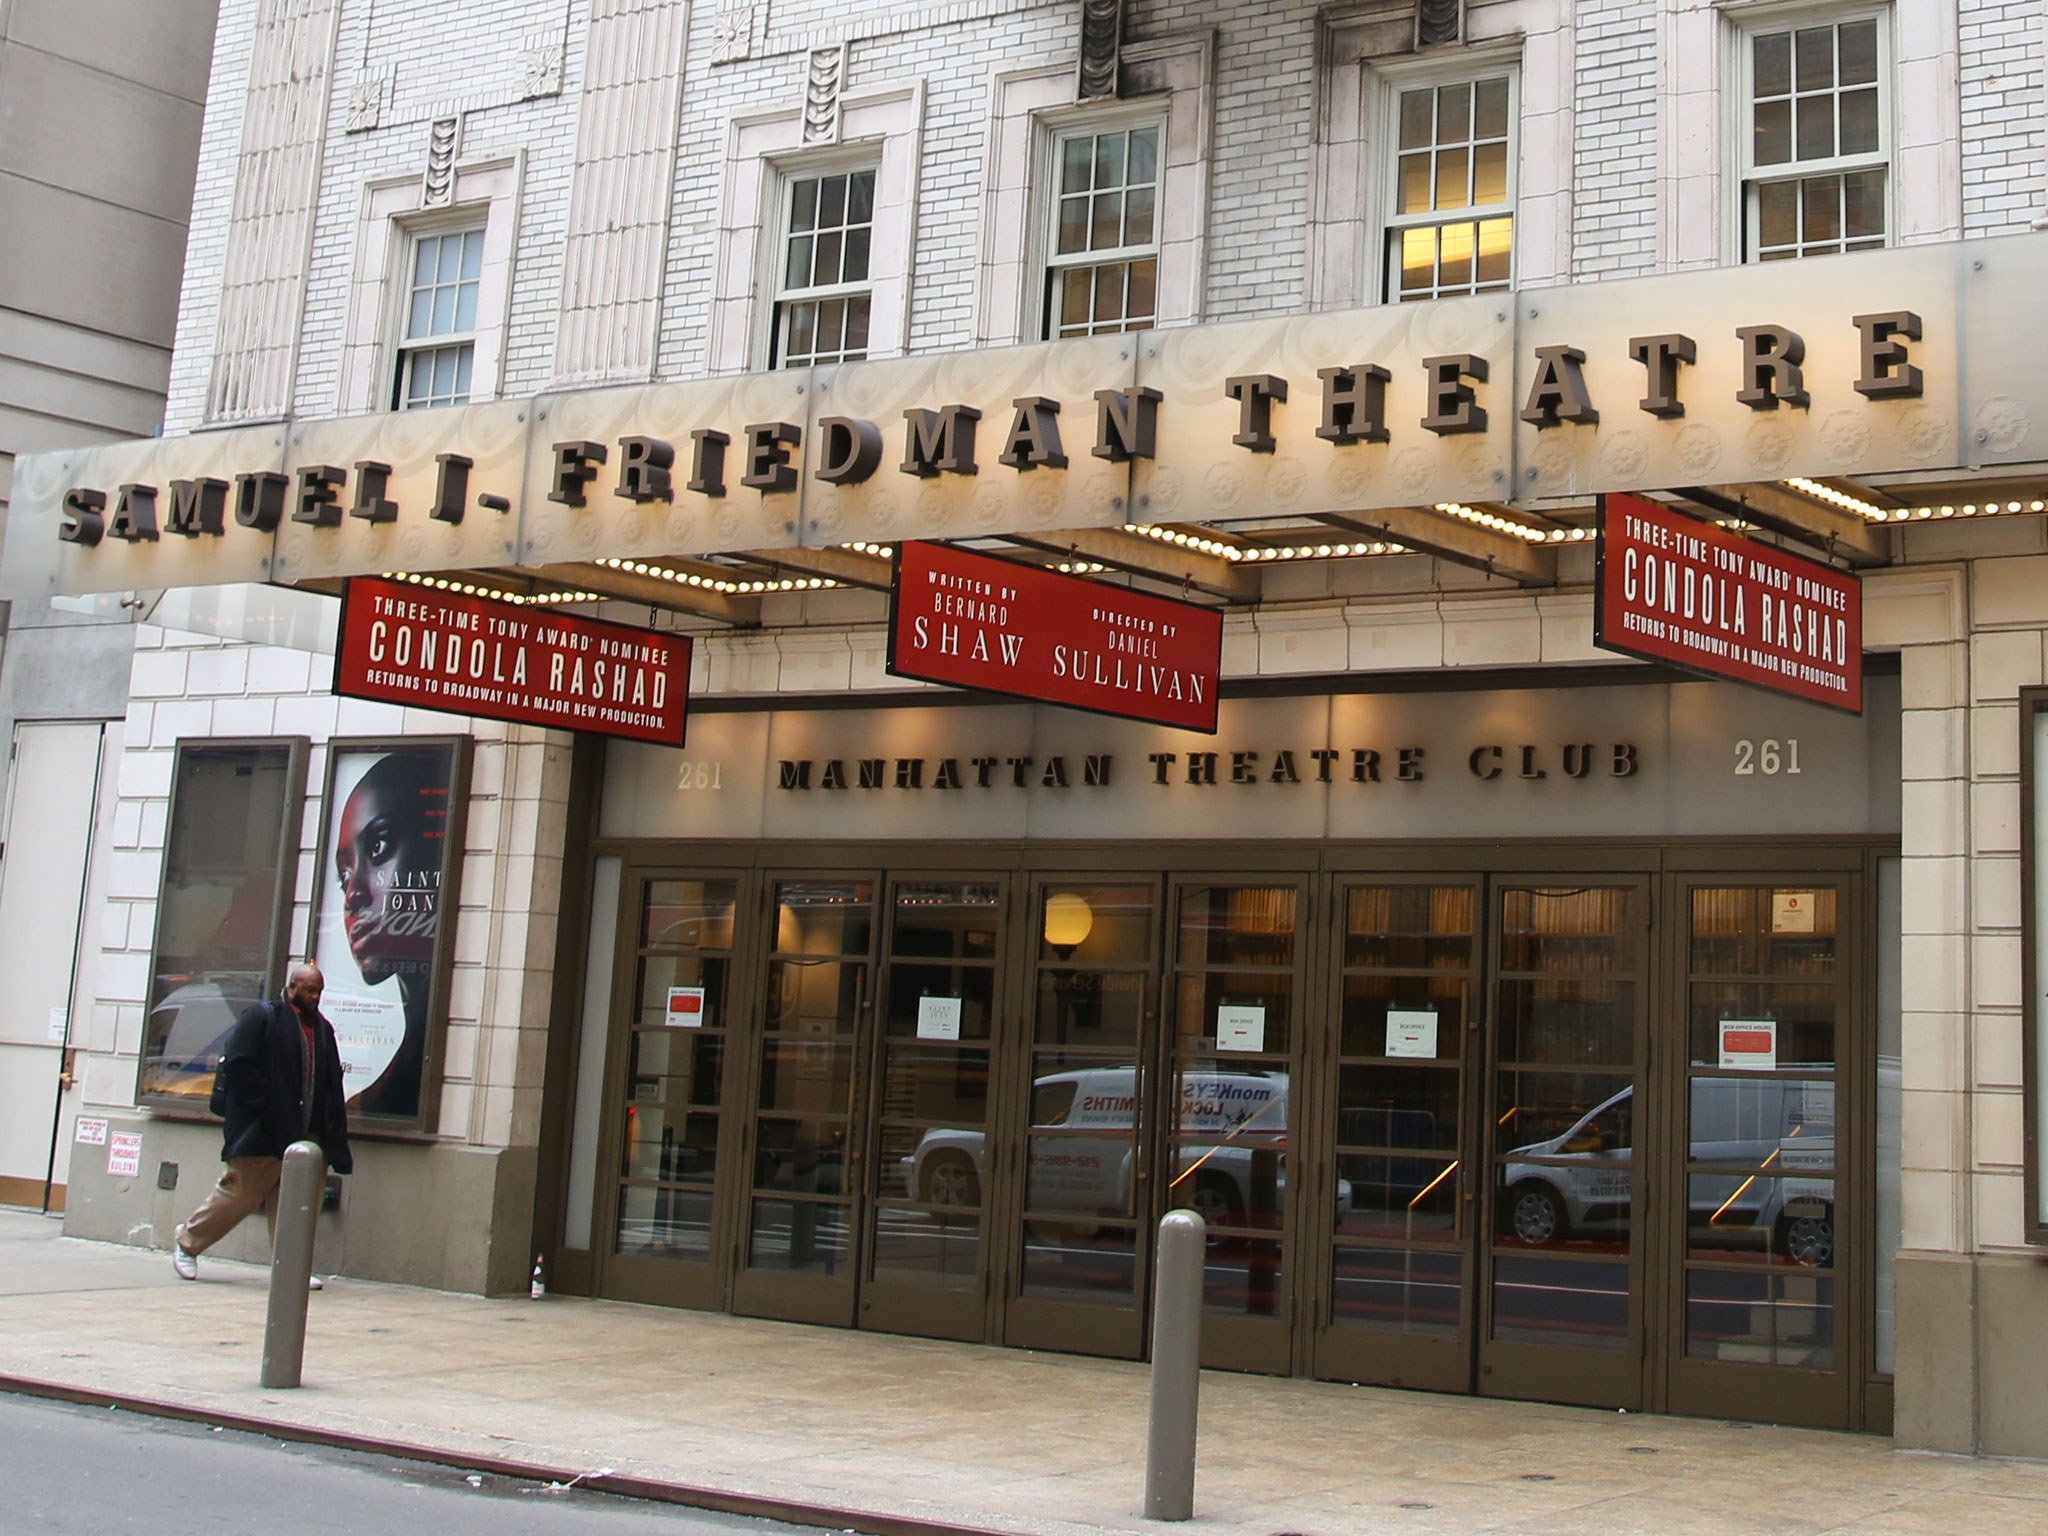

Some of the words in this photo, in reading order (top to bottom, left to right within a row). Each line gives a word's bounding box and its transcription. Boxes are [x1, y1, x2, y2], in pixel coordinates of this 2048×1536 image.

[58, 460, 398, 547] SAMUEL
[547, 385, 1164, 507] FRIEDMAN
[1224, 310, 1923, 454] THEATRE
[928, 570, 992, 596] WRITTEN
[1001, 587, 1017, 602] BY
[1625, 515, 1707, 563] THREE-TIME
[1713, 546, 1744, 575] TONY
[1796, 576, 1846, 612] NOMINEE
[374, 596, 480, 632] THREE-TIME
[488, 617, 529, 641] TONY
[600, 638, 669, 666] NOMINEE
[935, 592, 1008, 627] BERNARD
[1093, 608, 1155, 633] DIRECTED
[1162, 624, 1177, 638] BY
[1624, 547, 1746, 635] CONDOLA
[1762, 593, 1846, 667] RASHAD
[369, 620, 527, 686] CONDOLA
[549, 652, 667, 709] RASHAD
[913, 615, 1024, 667] SHAW
[1108, 630, 1158, 660] DANIEL
[1623, 611, 1665, 639] RETURNS
[1669, 624, 1680, 643] TO
[1683, 629, 1728, 657] BROADWAY
[1731, 643, 1741, 662] IN
[1743, 647, 1748, 663] A
[1751, 649, 1778, 671] MAJOR
[1781, 659, 1798, 677] NEW
[367, 669, 419, 690] RETURNS
[425, 679, 438, 693] TO
[443, 681, 503, 704] BROADWAY
[507, 692, 519, 705] IN
[523, 694, 530, 708] A
[534, 697, 569, 714] MAJOR
[573, 704, 597, 719] NEW
[1053, 644, 1205, 704] SULLIVAN
[677, 760, 722, 790] 261
[777, 754, 1113, 791] MANHATTAN
[1149, 747, 1424, 786] THEATRE
[1469, 742, 1639, 781] CLUB
[1734, 739, 1800, 775] 261
[376, 871, 442, 888] SAINT
[380, 894, 434, 914] JOAN
